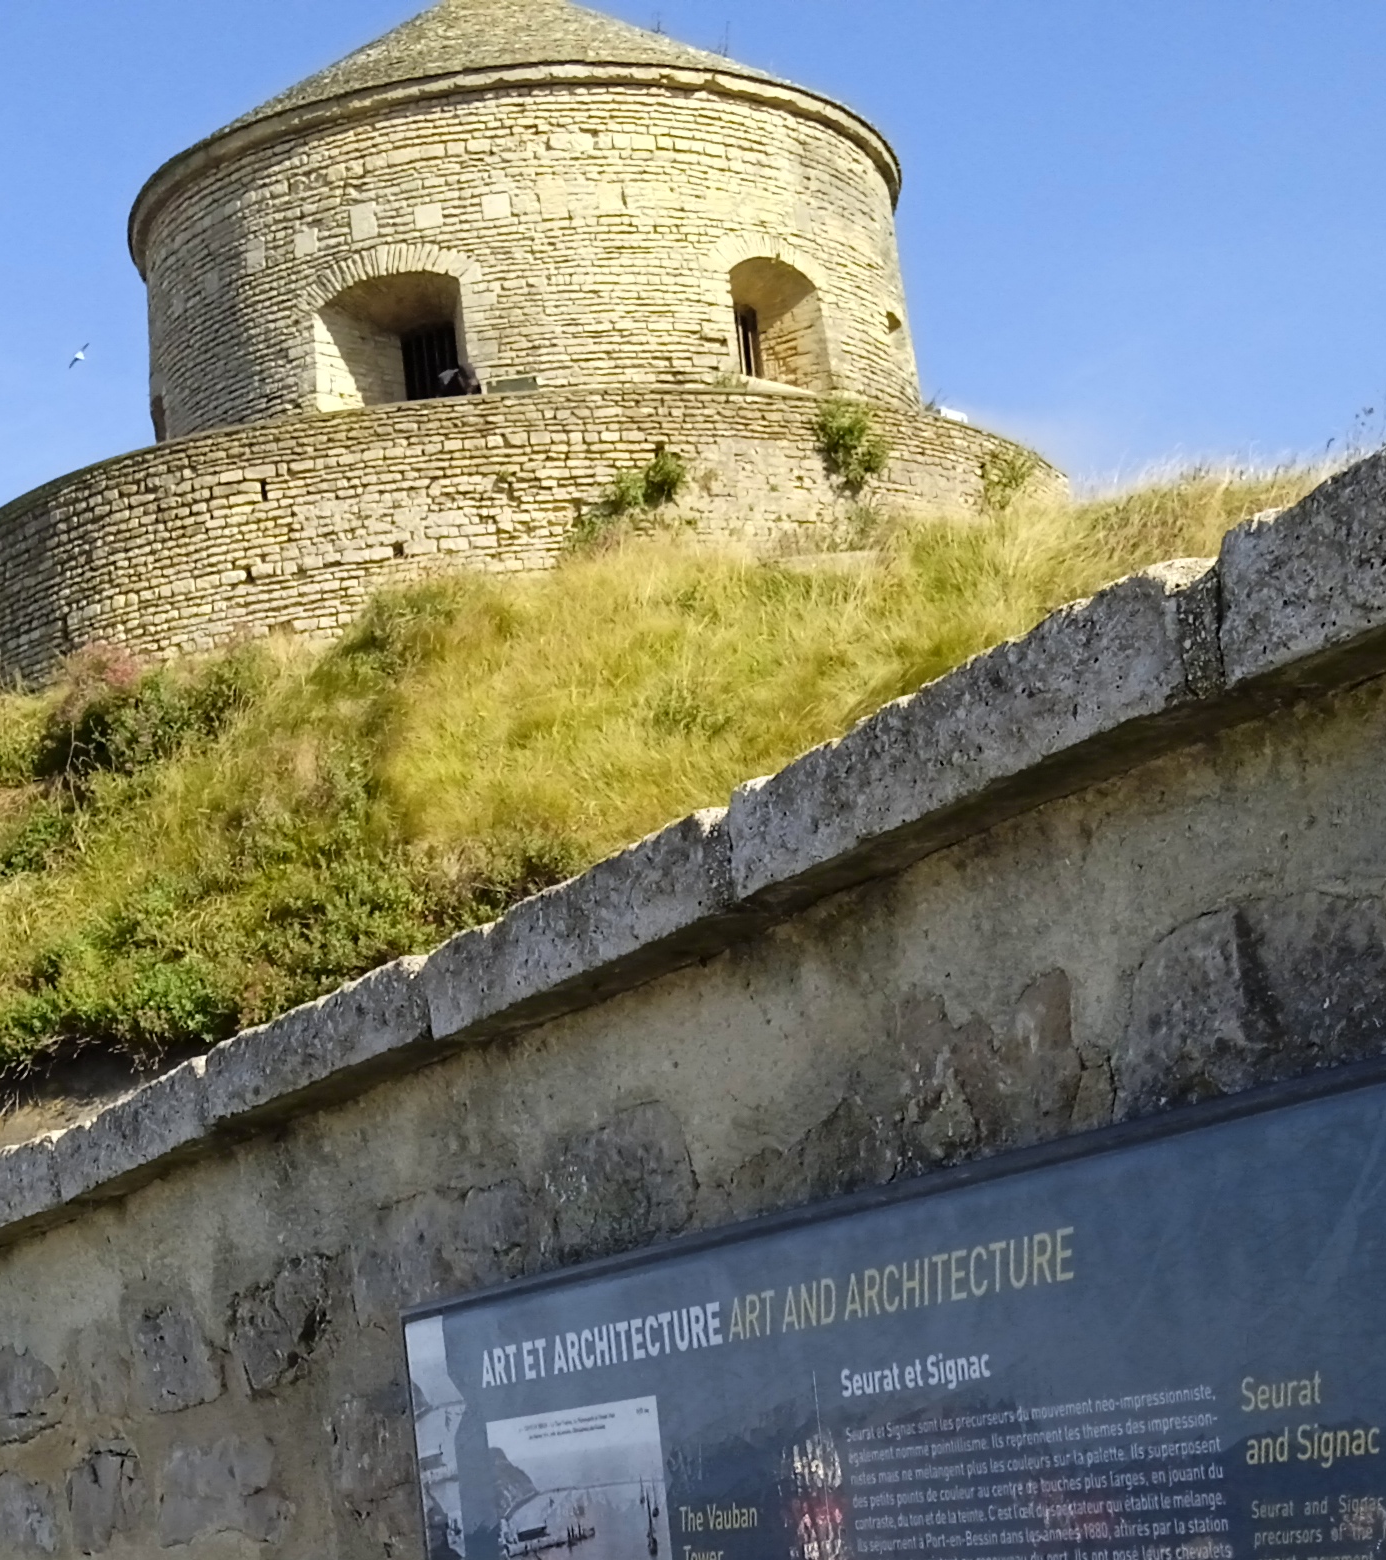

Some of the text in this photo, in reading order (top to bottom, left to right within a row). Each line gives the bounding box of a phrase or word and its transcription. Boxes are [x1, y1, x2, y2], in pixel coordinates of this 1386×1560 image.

[481, 1226, 1075, 1389] ART ET ARCHITECTURE ART AND ARCHITECTURE
[840, 1352, 992, 1398] Seurat et Signac
[1240, 1370, 1322, 1413] Seurat
[1245, 1422, 1381, 1469] and Signac
[679, 1501, 758, 1533] The Vauban
